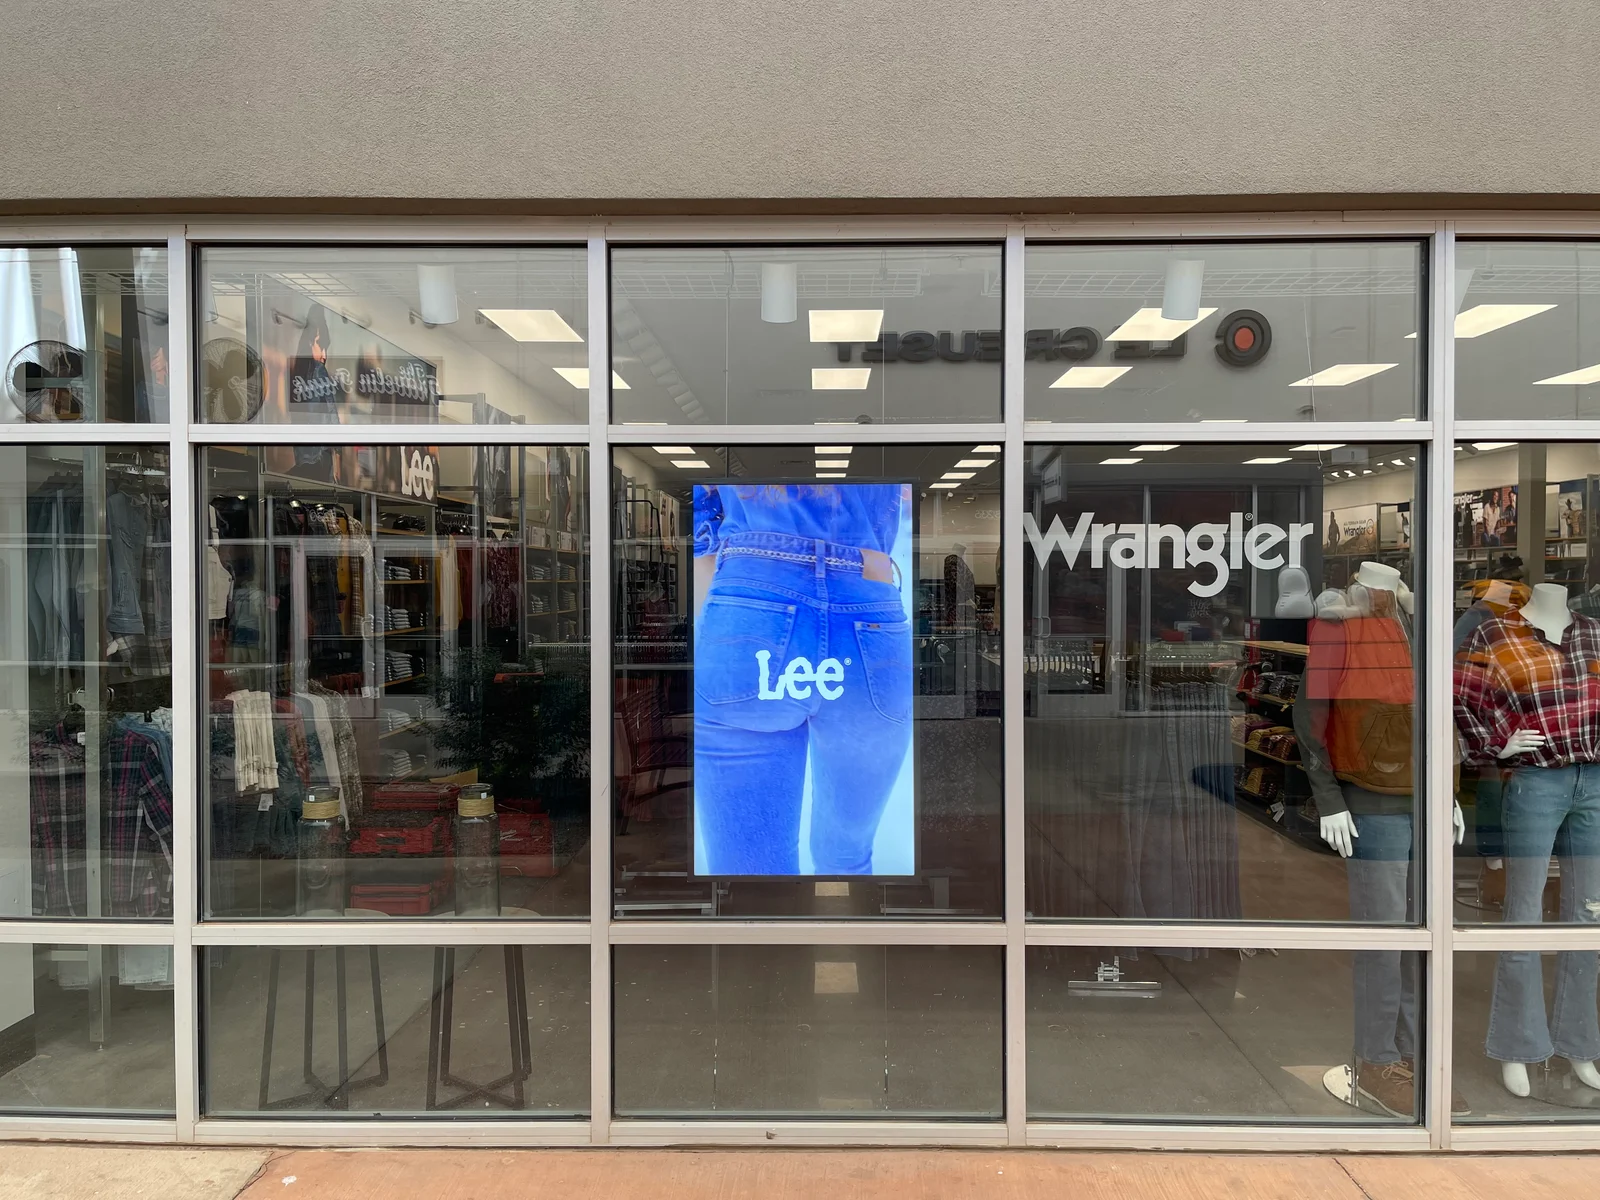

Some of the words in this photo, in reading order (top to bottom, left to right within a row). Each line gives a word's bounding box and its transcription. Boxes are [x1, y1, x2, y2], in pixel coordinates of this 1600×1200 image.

[400, 445, 434, 501] Lee
[1453, 493, 1474, 509] angler
[1023, 511, 1314, 598] Wrangler
[755, 649, 845, 701] Lee
